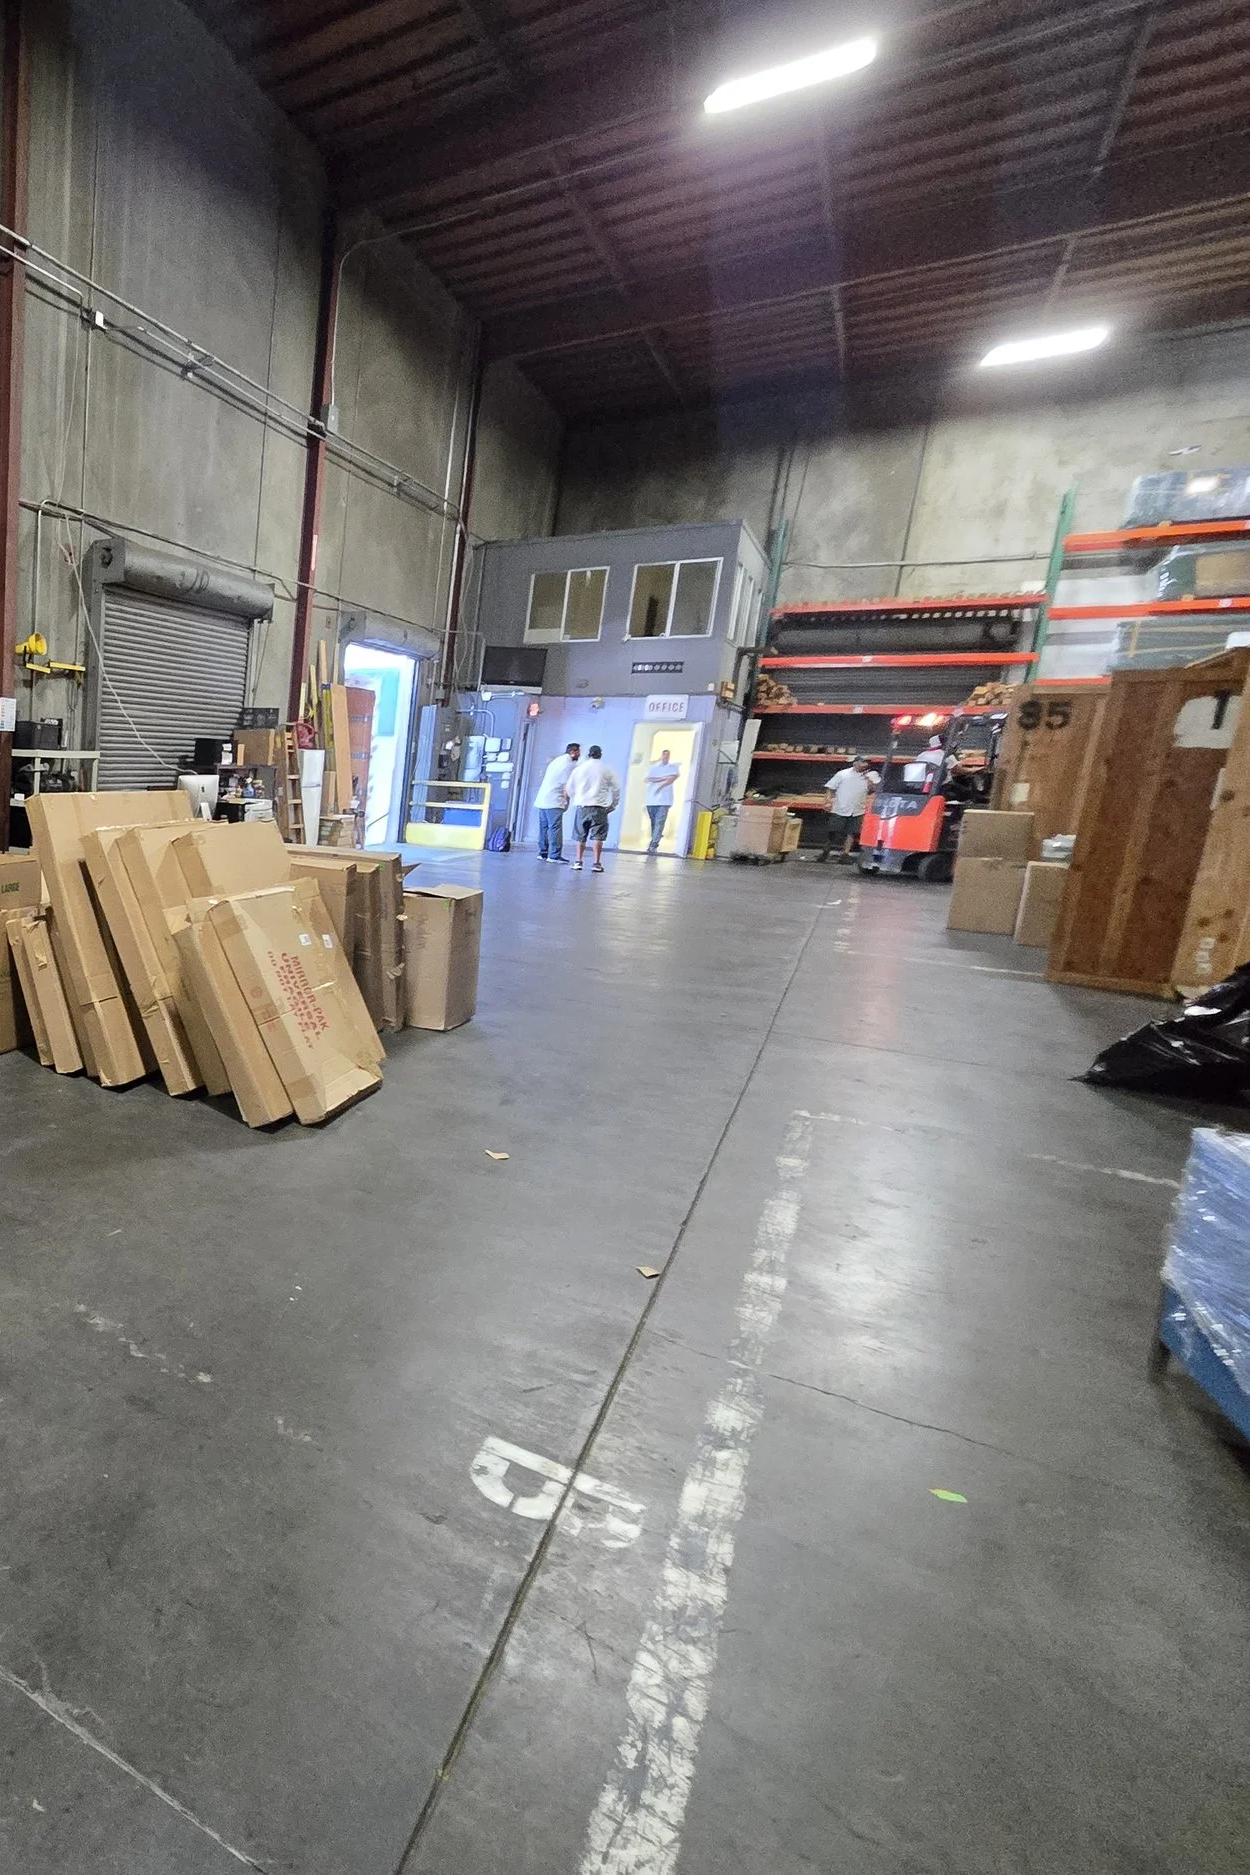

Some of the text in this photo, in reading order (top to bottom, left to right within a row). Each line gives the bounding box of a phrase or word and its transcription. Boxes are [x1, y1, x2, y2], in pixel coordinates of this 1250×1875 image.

[648, 702, 684, 713] OFFICE
[279, 965, 311, 1031] FRAGILE
[281, 952, 321, 1040] UNIVERSAL
[290, 955, 330, 1031] MIRROR-PAK
